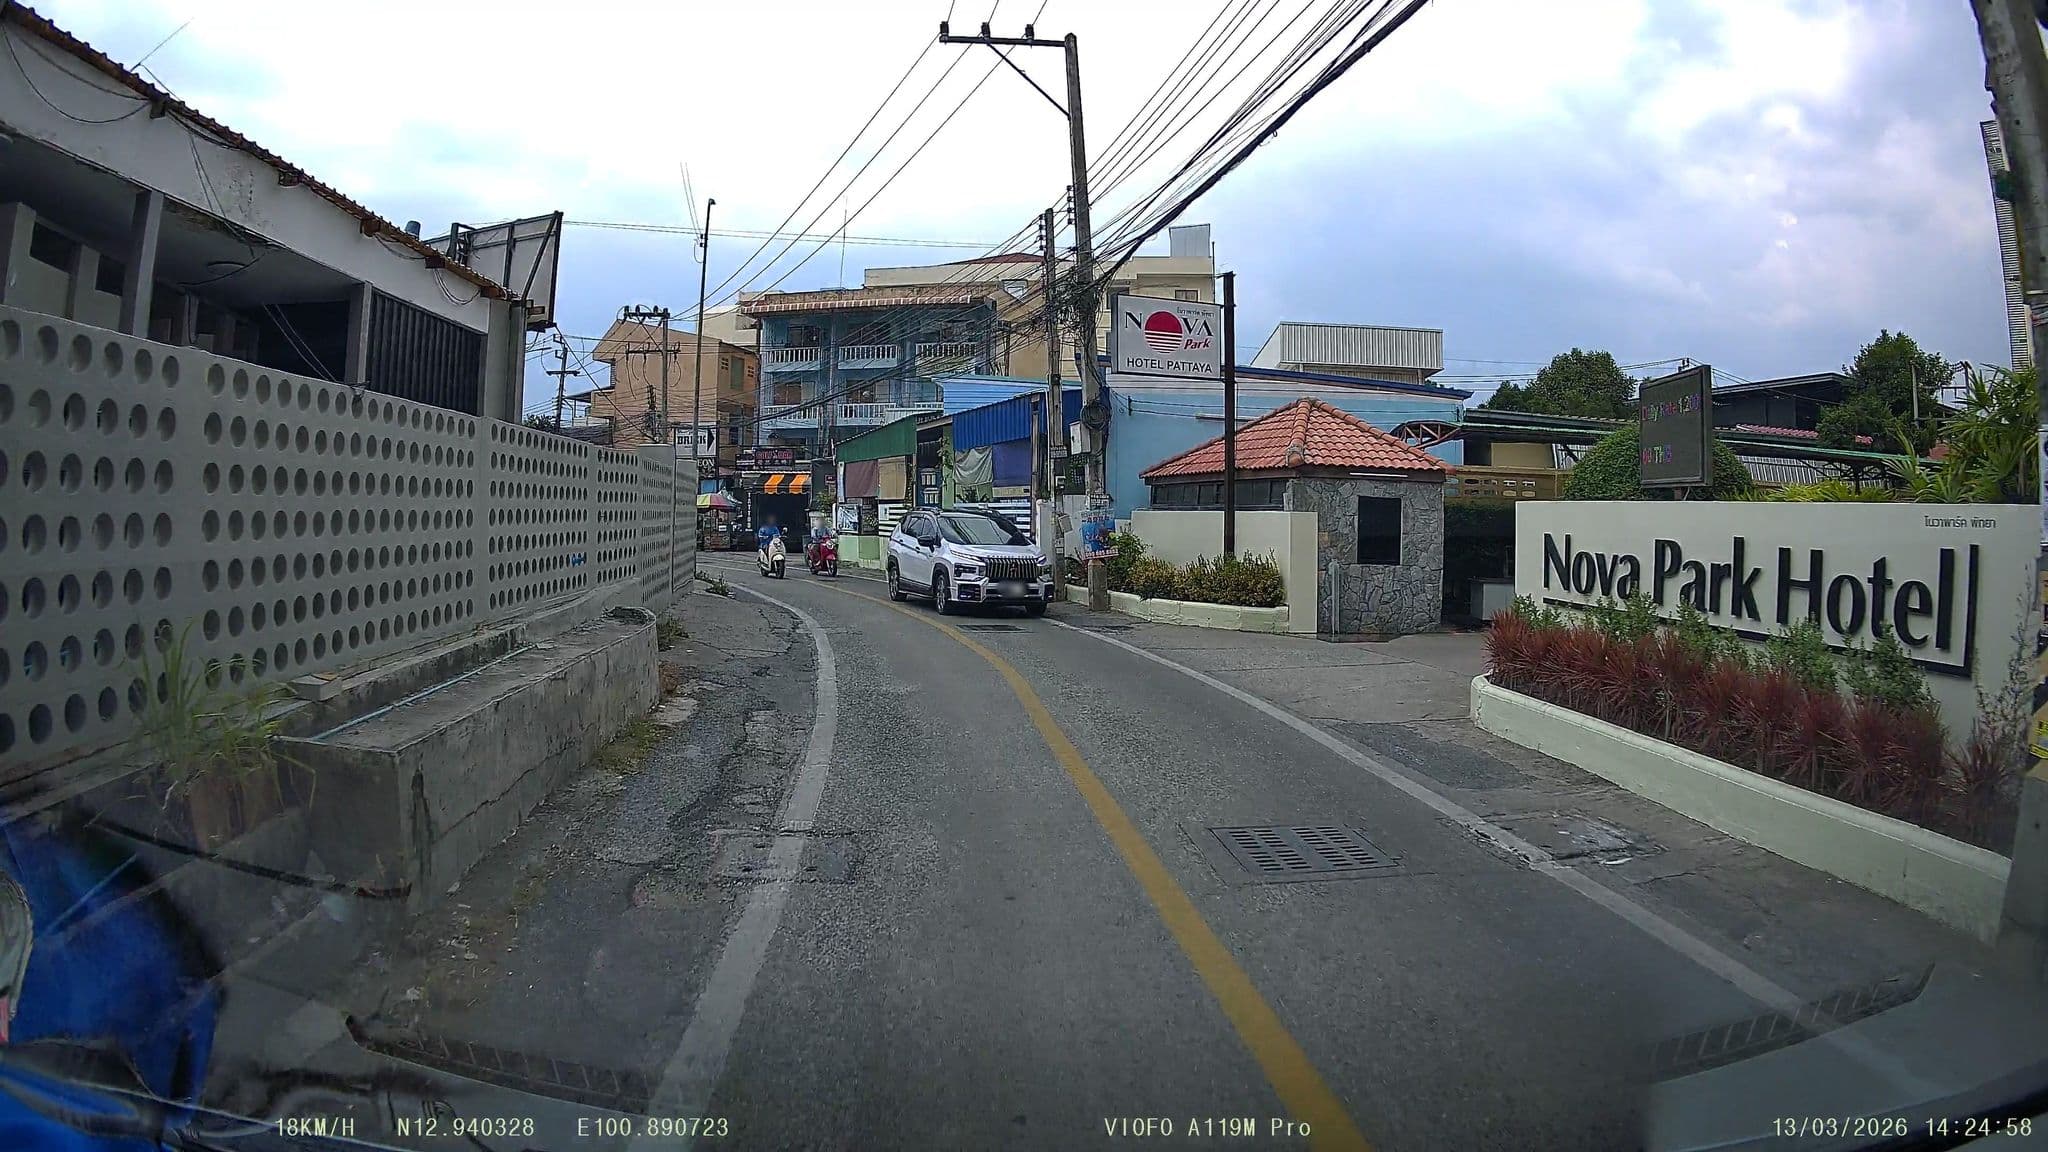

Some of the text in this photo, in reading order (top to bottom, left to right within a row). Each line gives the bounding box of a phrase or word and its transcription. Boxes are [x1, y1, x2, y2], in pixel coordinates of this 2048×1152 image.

[1184, 338, 1211, 350] Park
[1127, 357, 1213, 374] HOTEL PATTAYA
[677, 435, 706, 445] BRIK
[1970, 516, 1996, 529] พัทยา
[1543, 532, 1640, 599] Nova
[1654, 536, 1762, 622] Park
[1776, 548, 1955, 650] Hotel
